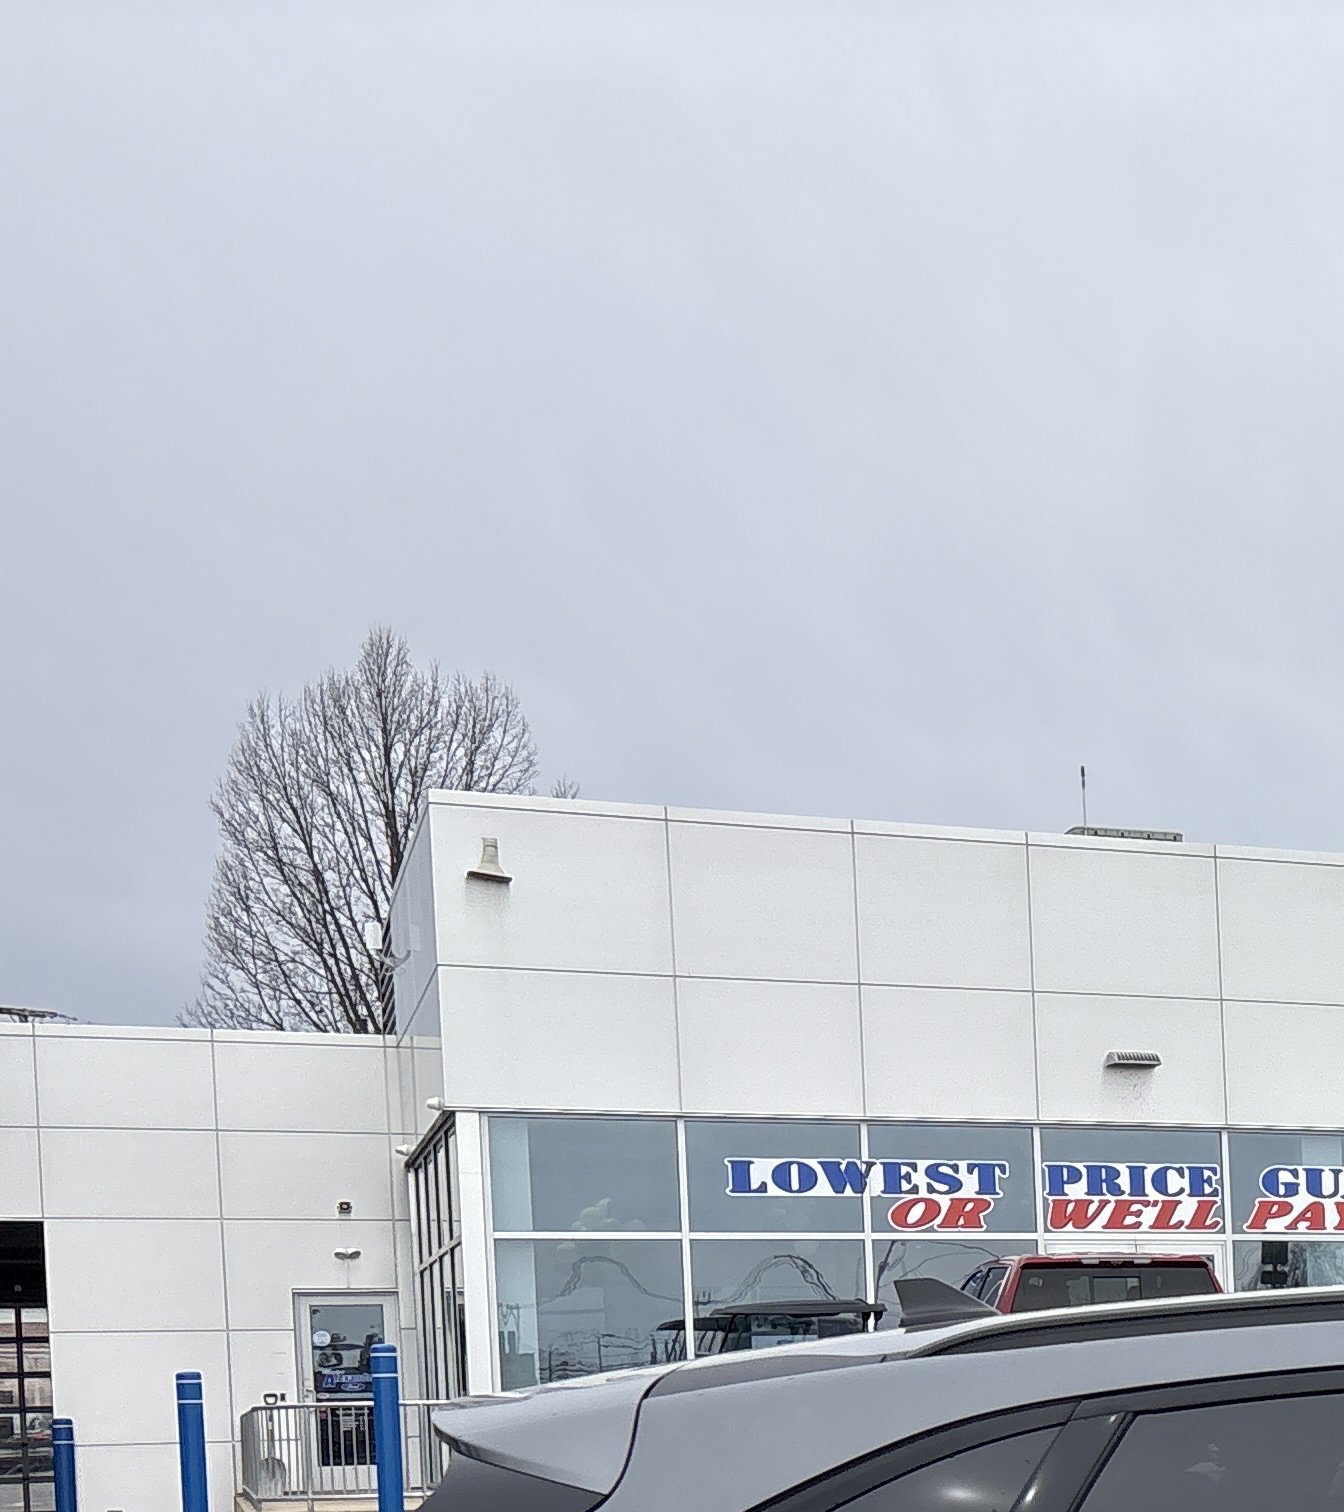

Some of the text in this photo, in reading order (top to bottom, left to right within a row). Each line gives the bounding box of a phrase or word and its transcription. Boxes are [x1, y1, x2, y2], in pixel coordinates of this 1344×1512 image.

[729, 1160, 1006, 1197] LOWEST
[1044, 1163, 1221, 1198] PRICE
[890, 1198, 992, 1230] OR
[1046, 1199, 1221, 1230] WE'LL
